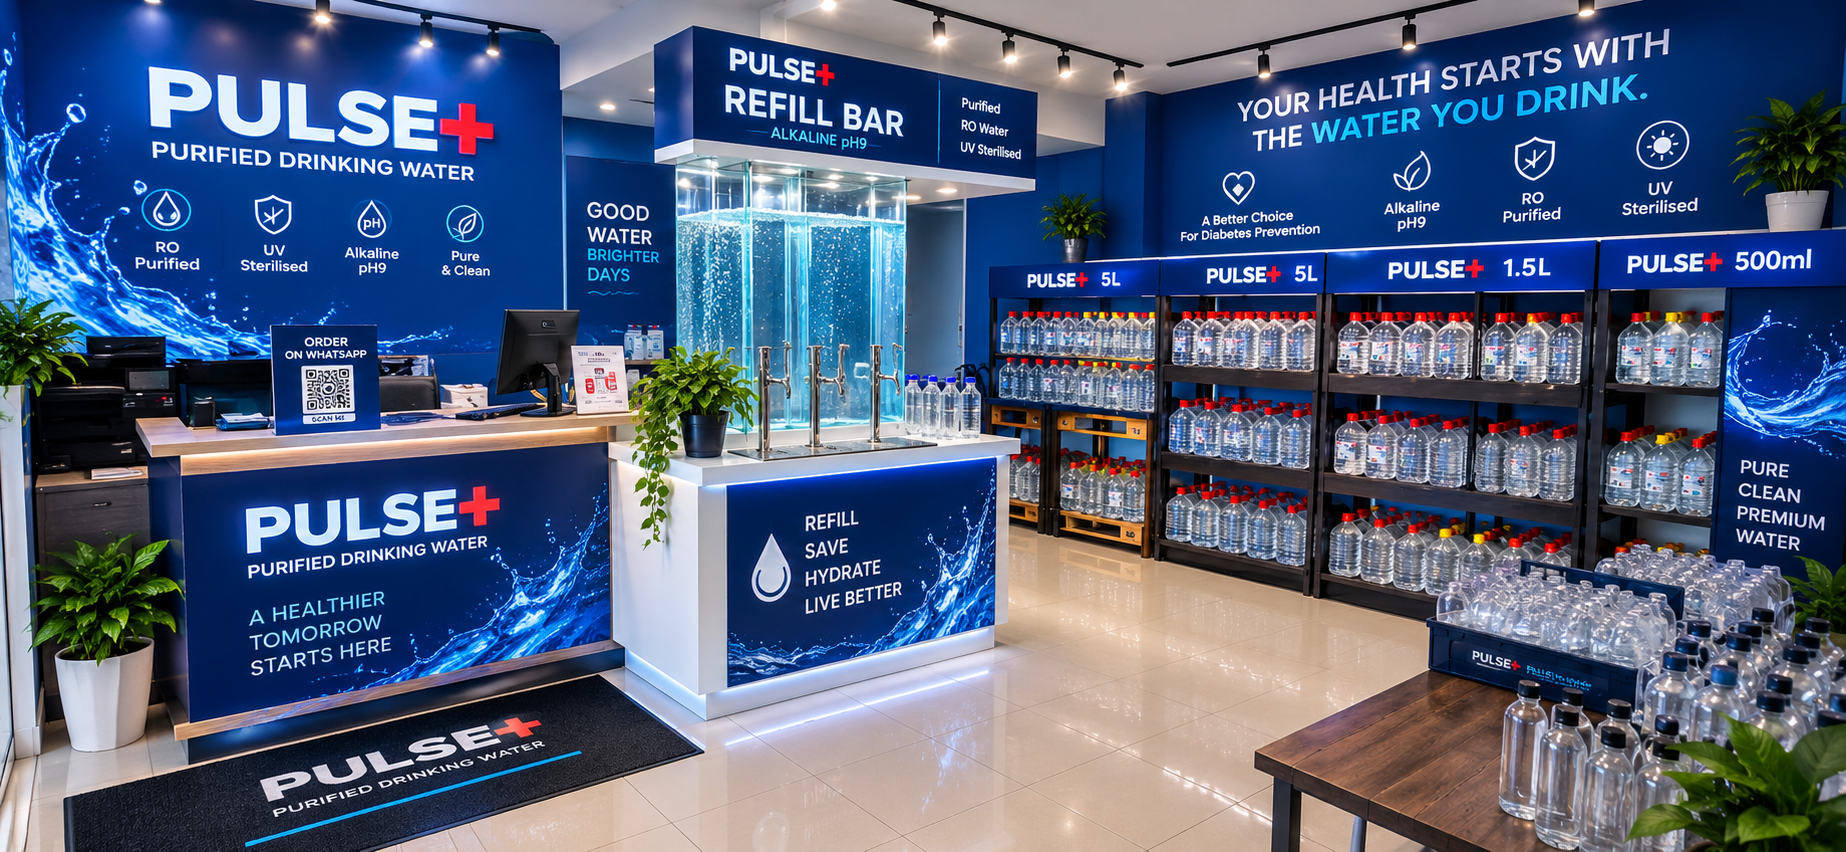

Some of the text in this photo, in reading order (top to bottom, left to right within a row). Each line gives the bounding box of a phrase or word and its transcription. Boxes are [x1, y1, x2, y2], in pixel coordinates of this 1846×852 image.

[1238, 29, 1669, 121] YOUR HEALTH STARTS WITH
[726, 85, 903, 136] REFILL BAR
[961, 97, 1001, 115] Purified
[1253, 74, 1647, 151] THE WATER YOU DRINK.
[961, 119, 1009, 137] RO Water
[770, 126, 867, 151] ALKALINE pH9
[960, 141, 1022, 160] UV Sterilised
[152, 141, 474, 182] PURIFIED DRINKING WATER
[1648, 180, 1673, 196] UV
[1383, 200, 1441, 215] Alkaline
[1521, 191, 1545, 205] RO
[1621, 197, 1698, 216] Sterilised
[586, 201, 650, 222] GOOD
[1201, 210, 1294, 227] A Better Choice
[1503, 206, 1562, 223] Purified
[363, 217, 381, 231] pH
[1180, 223, 1321, 242] For Diabetes Prevention
[1397, 216, 1427, 233] pH9
[586, 226, 652, 246] WATER
[155, 241, 180, 254] RO
[263, 244, 286, 257] UV
[344, 246, 400, 260] Alkaline
[451, 250, 480, 262] Pure
[587, 247, 660, 263] BRIGHTER
[135, 256, 200, 271] Purified
[240, 259, 308, 273] Sterilised
[358, 262, 387, 276] pH9
[1503, 257, 1551, 277] 1.5L
[1734, 248, 1812, 271] 500ml
[441, 264, 491, 277] & Clean
[587, 266, 630, 282] DAYS
[1101, 271, 1121, 287] 5L
[1294, 264, 1318, 283] 5L
[304, 336, 349, 347] ORDER
[284, 349, 367, 360] ON WHATSAPP
[1740, 459, 1790, 479] PURE
[1738, 482, 1801, 504] CLEAN
[805, 510, 859, 532] REFILL
[1737, 506, 1825, 530] PREMIUM
[805, 537, 849, 560] SAVE
[1736, 529, 1800, 551] WATER
[248, 535, 488, 578] PURIFIED DRINKING WATER
[806, 560, 880, 586] HYDRATE
[805, 582, 901, 615] LIVE BETTER
[248, 592, 384, 627] A HEALTHIER
[249, 615, 382, 651] TOMORROW
[251, 637, 391, 675] STARTS HERE
[272, 740, 546, 818] PURIFIED DRINKING WATER
